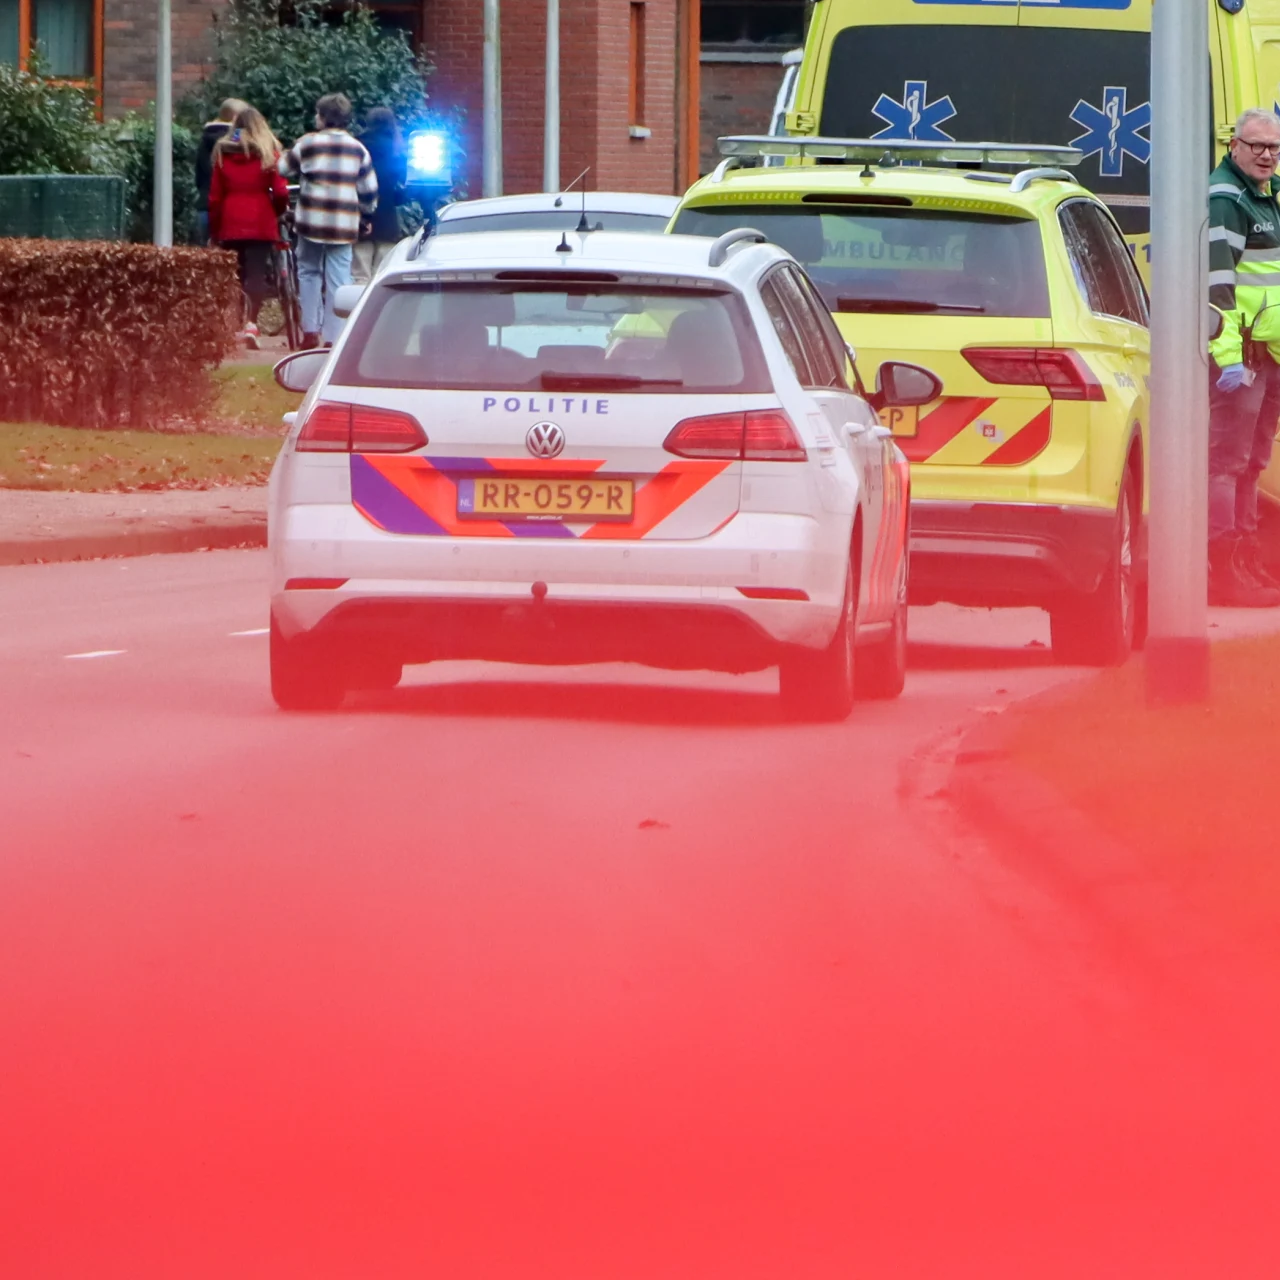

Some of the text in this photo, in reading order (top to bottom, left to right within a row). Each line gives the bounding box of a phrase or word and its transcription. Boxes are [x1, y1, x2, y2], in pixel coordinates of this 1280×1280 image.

[822, 240, 965, 262] MBULANC
[483, 397, 609, 414] POLITIE
[482, 483, 624, 511] RR-059-R
